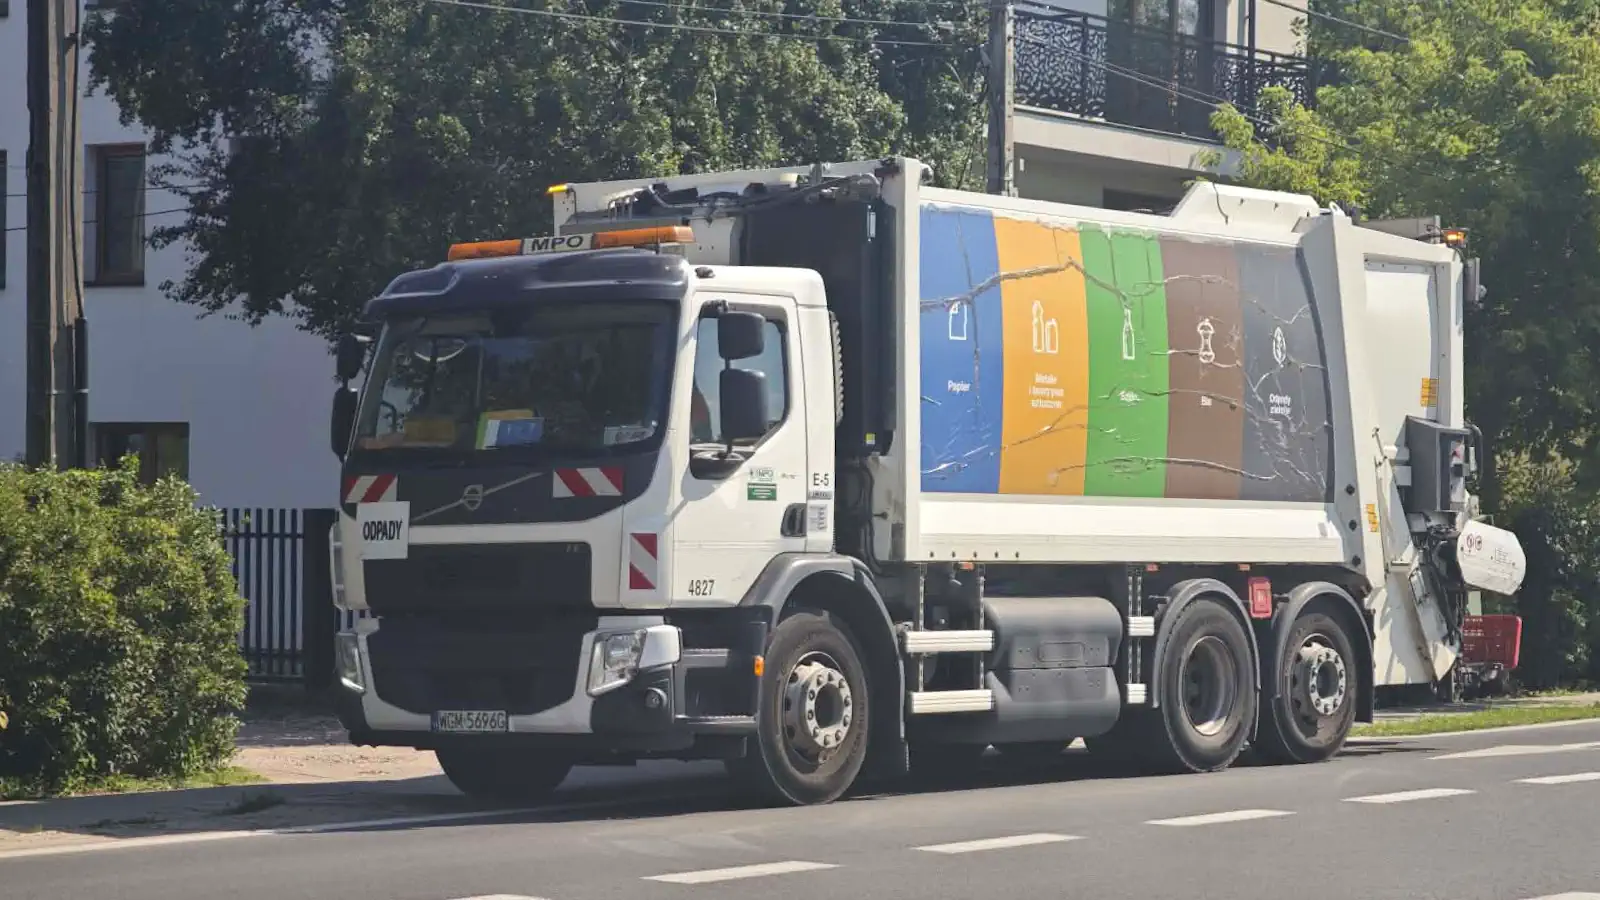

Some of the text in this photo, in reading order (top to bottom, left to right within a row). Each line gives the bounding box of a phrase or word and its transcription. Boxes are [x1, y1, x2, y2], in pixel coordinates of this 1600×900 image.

[531, 235, 583, 252] MPO
[947, 380, 971, 394] Papier
[813, 473, 829, 486] E-5
[362, 520, 403, 541] ODPADY
[687, 579, 715, 596] 4827
[439, 711, 505, 729] WGM 5696G
